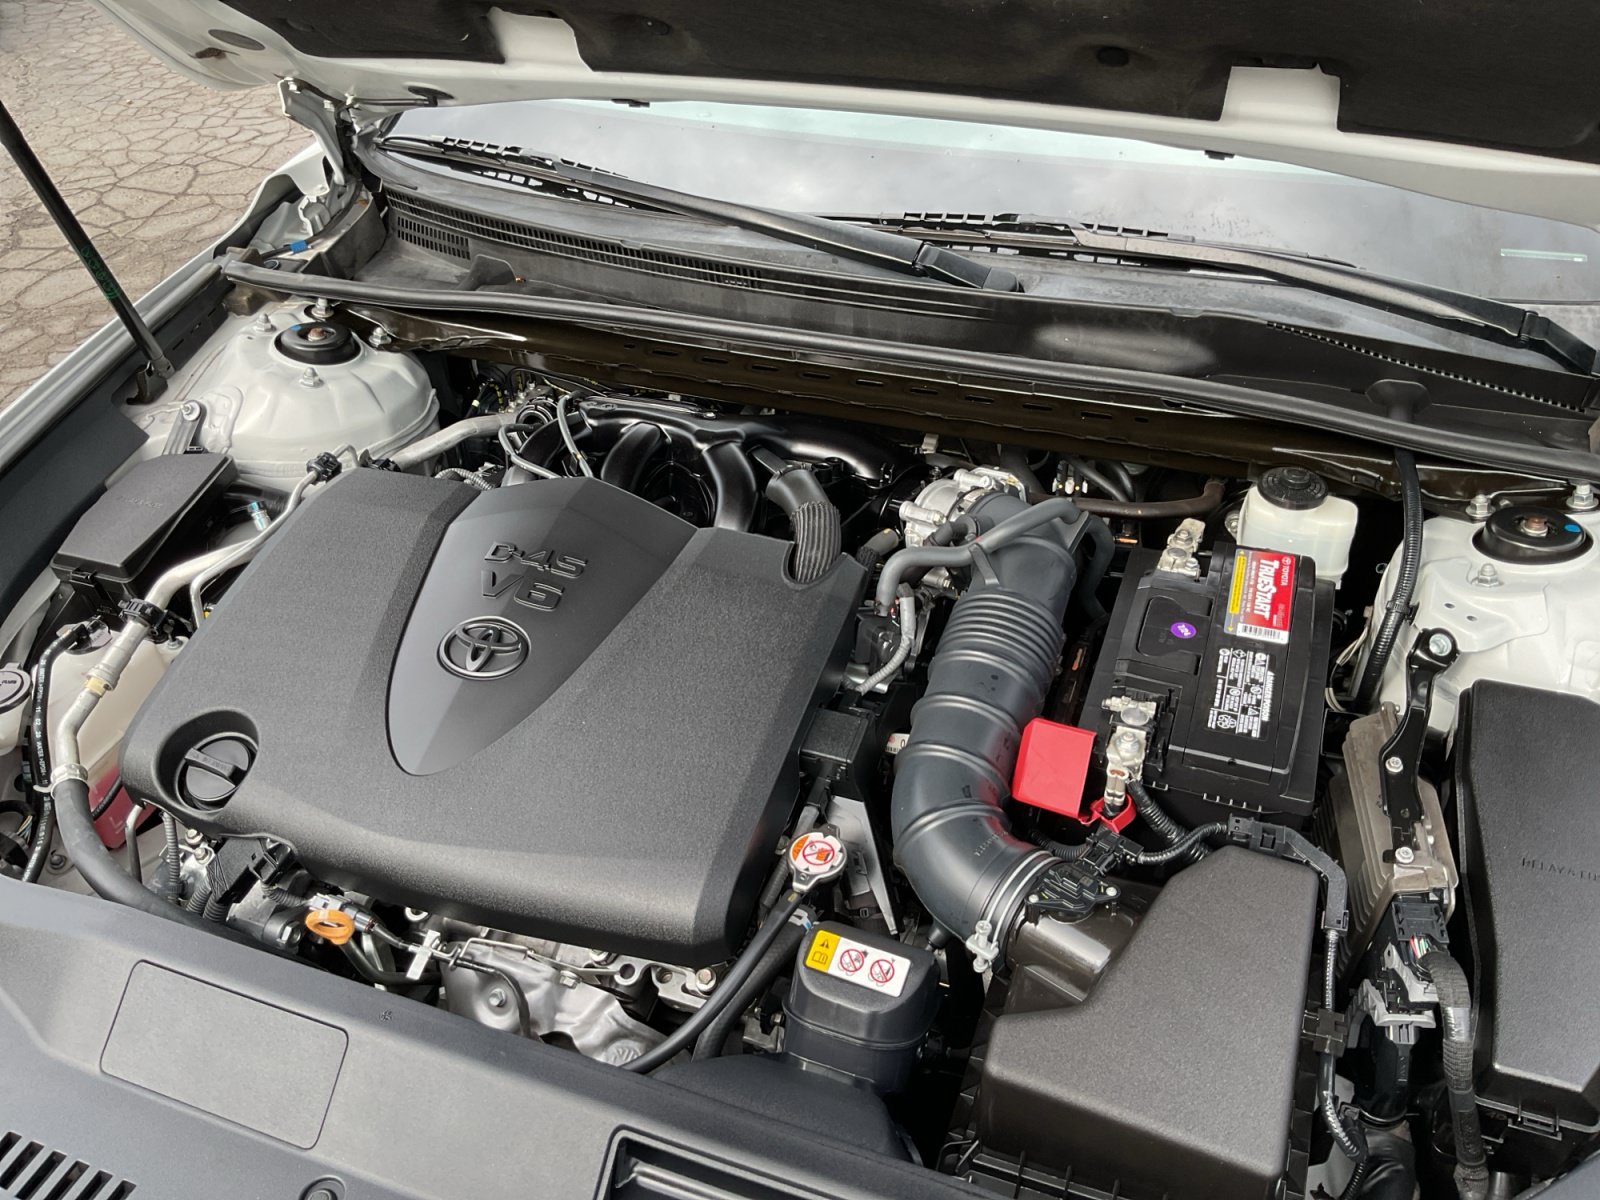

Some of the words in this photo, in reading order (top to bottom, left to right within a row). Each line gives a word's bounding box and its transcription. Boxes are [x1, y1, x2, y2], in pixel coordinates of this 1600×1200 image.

[484, 542, 588, 579] D-4S
[1281, 565, 1290, 586] TOYOTA
[481, 570, 565, 612] V6
